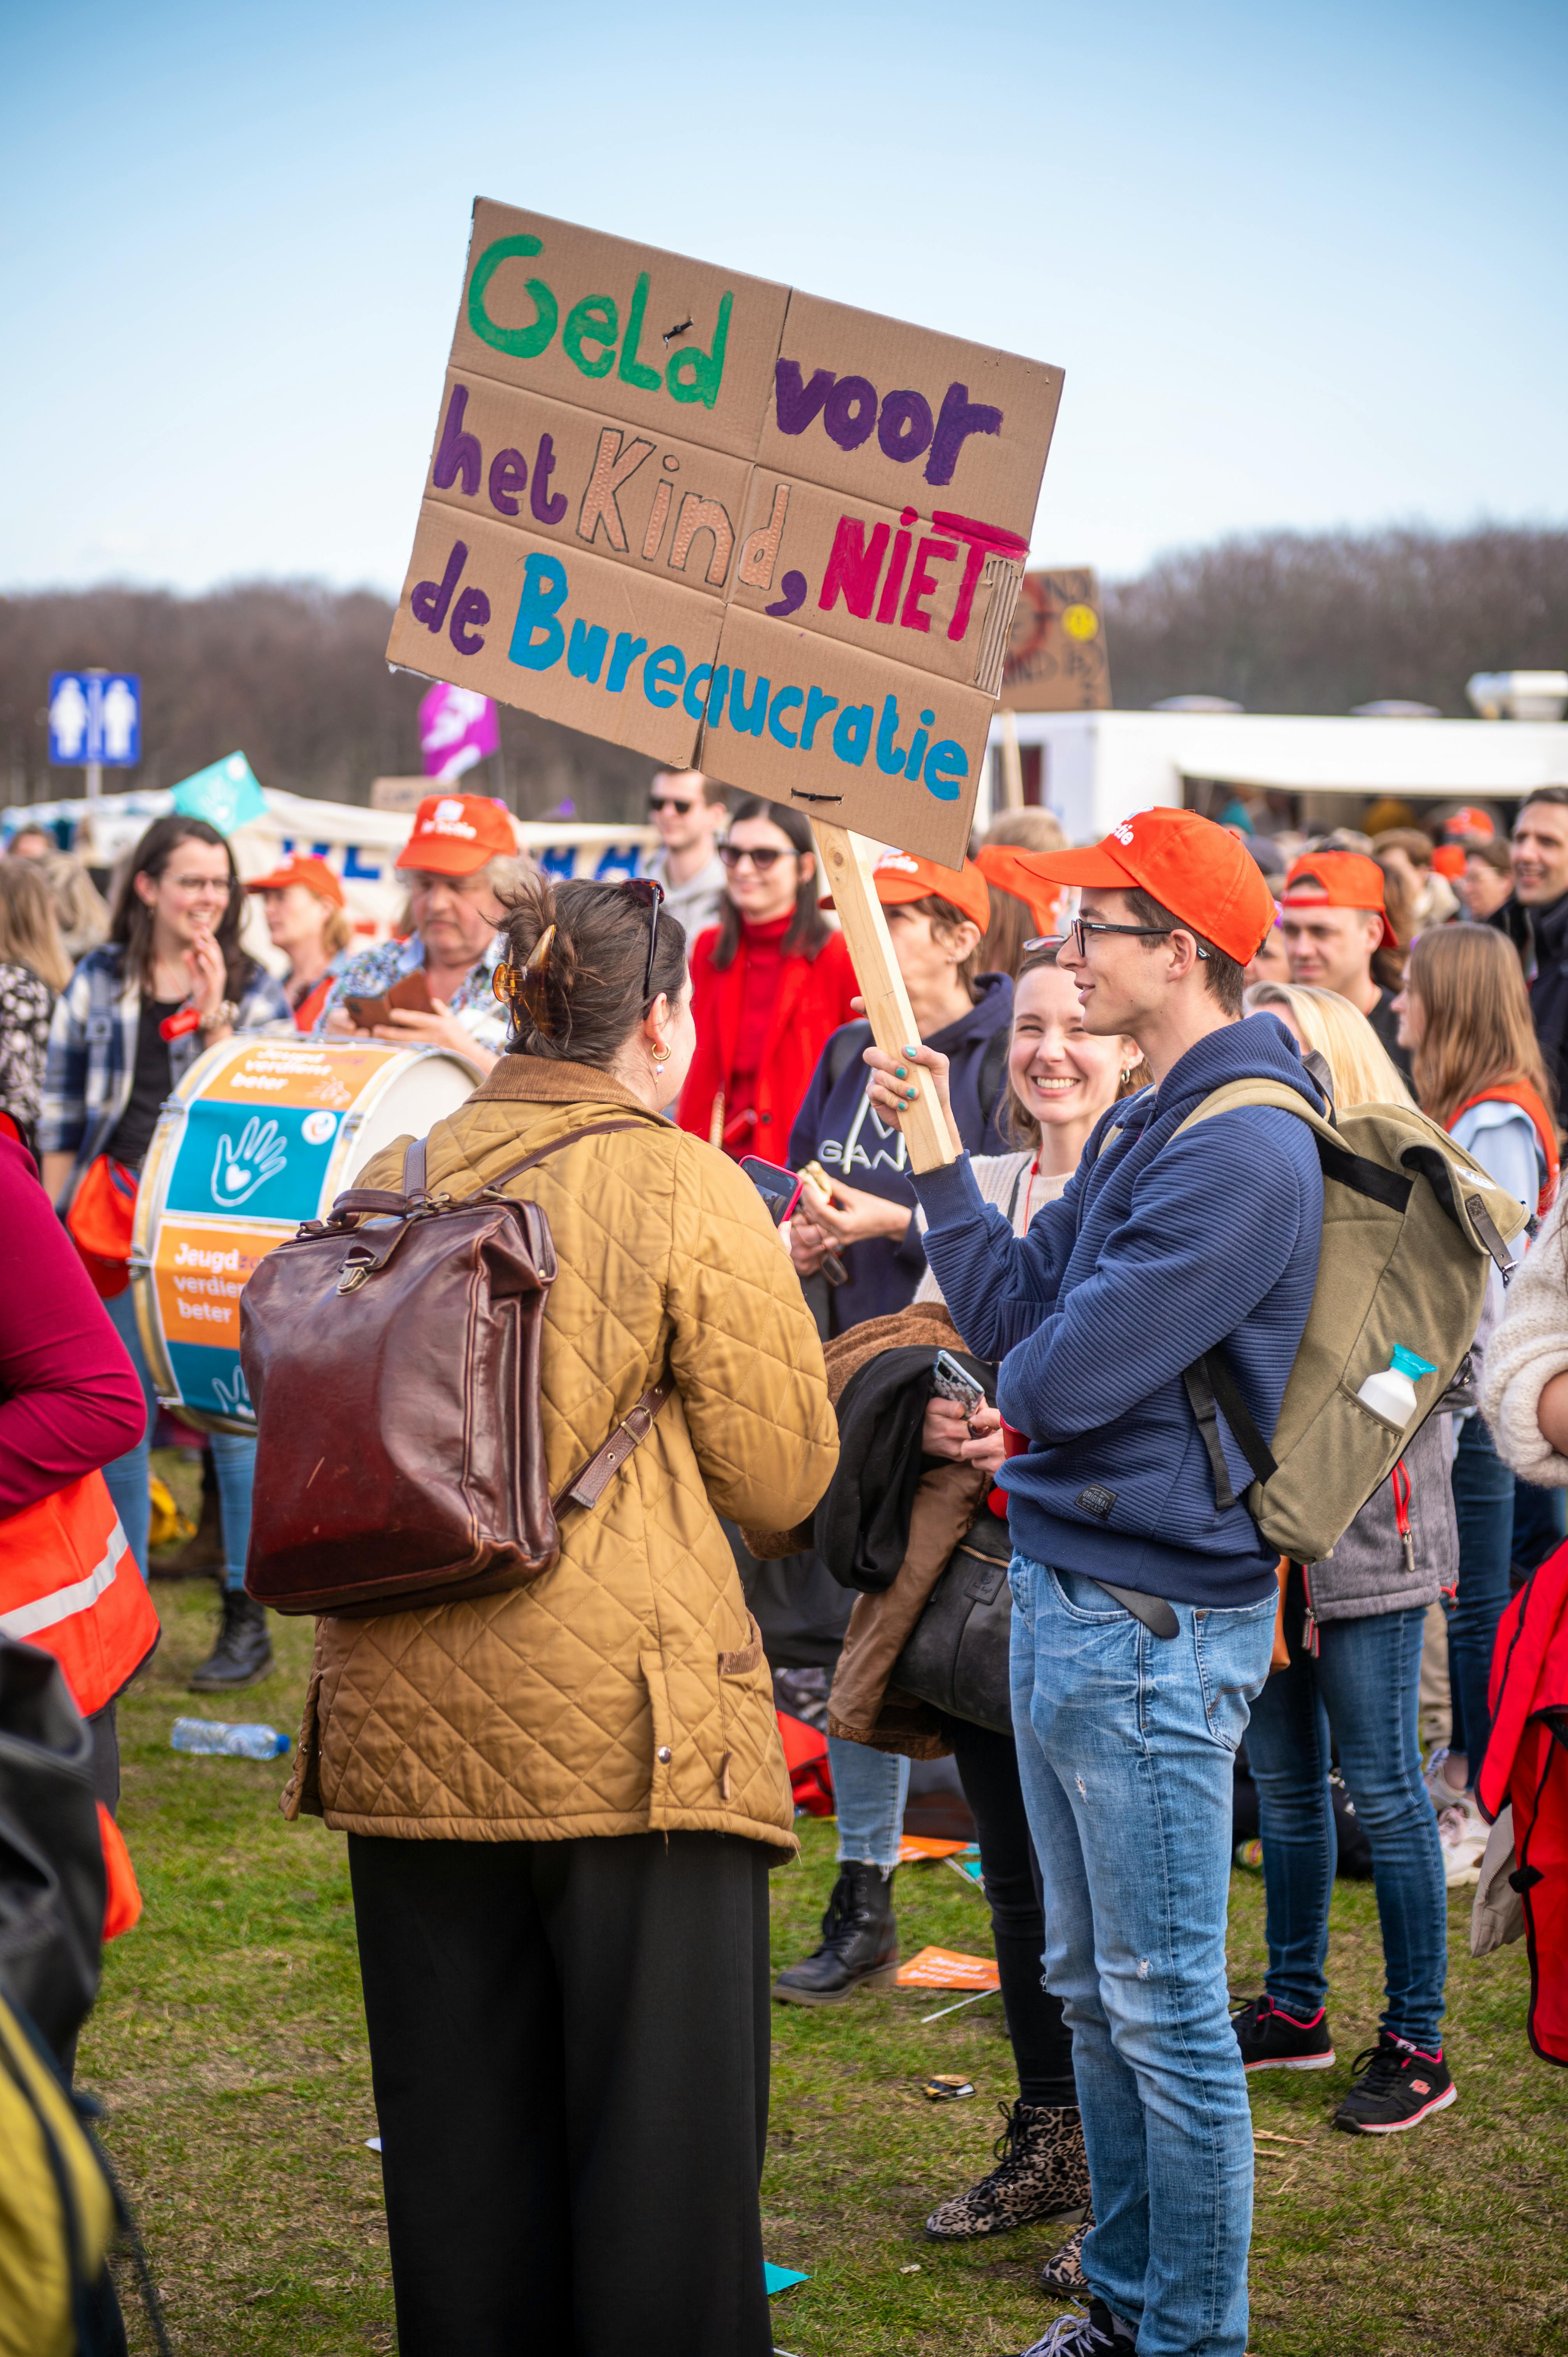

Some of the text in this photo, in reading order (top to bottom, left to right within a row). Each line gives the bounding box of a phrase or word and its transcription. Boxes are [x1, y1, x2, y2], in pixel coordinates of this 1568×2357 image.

[432, 385, 569, 525] het
[775, 357, 1004, 487] voor
[411, 540, 969, 801] de Bureaucratie
[177, 1297, 232, 1323] beter
[1082, 1498, 1094, 1506] SUPPLY
[1083, 1490, 1108, 1509] ORIGINAL
